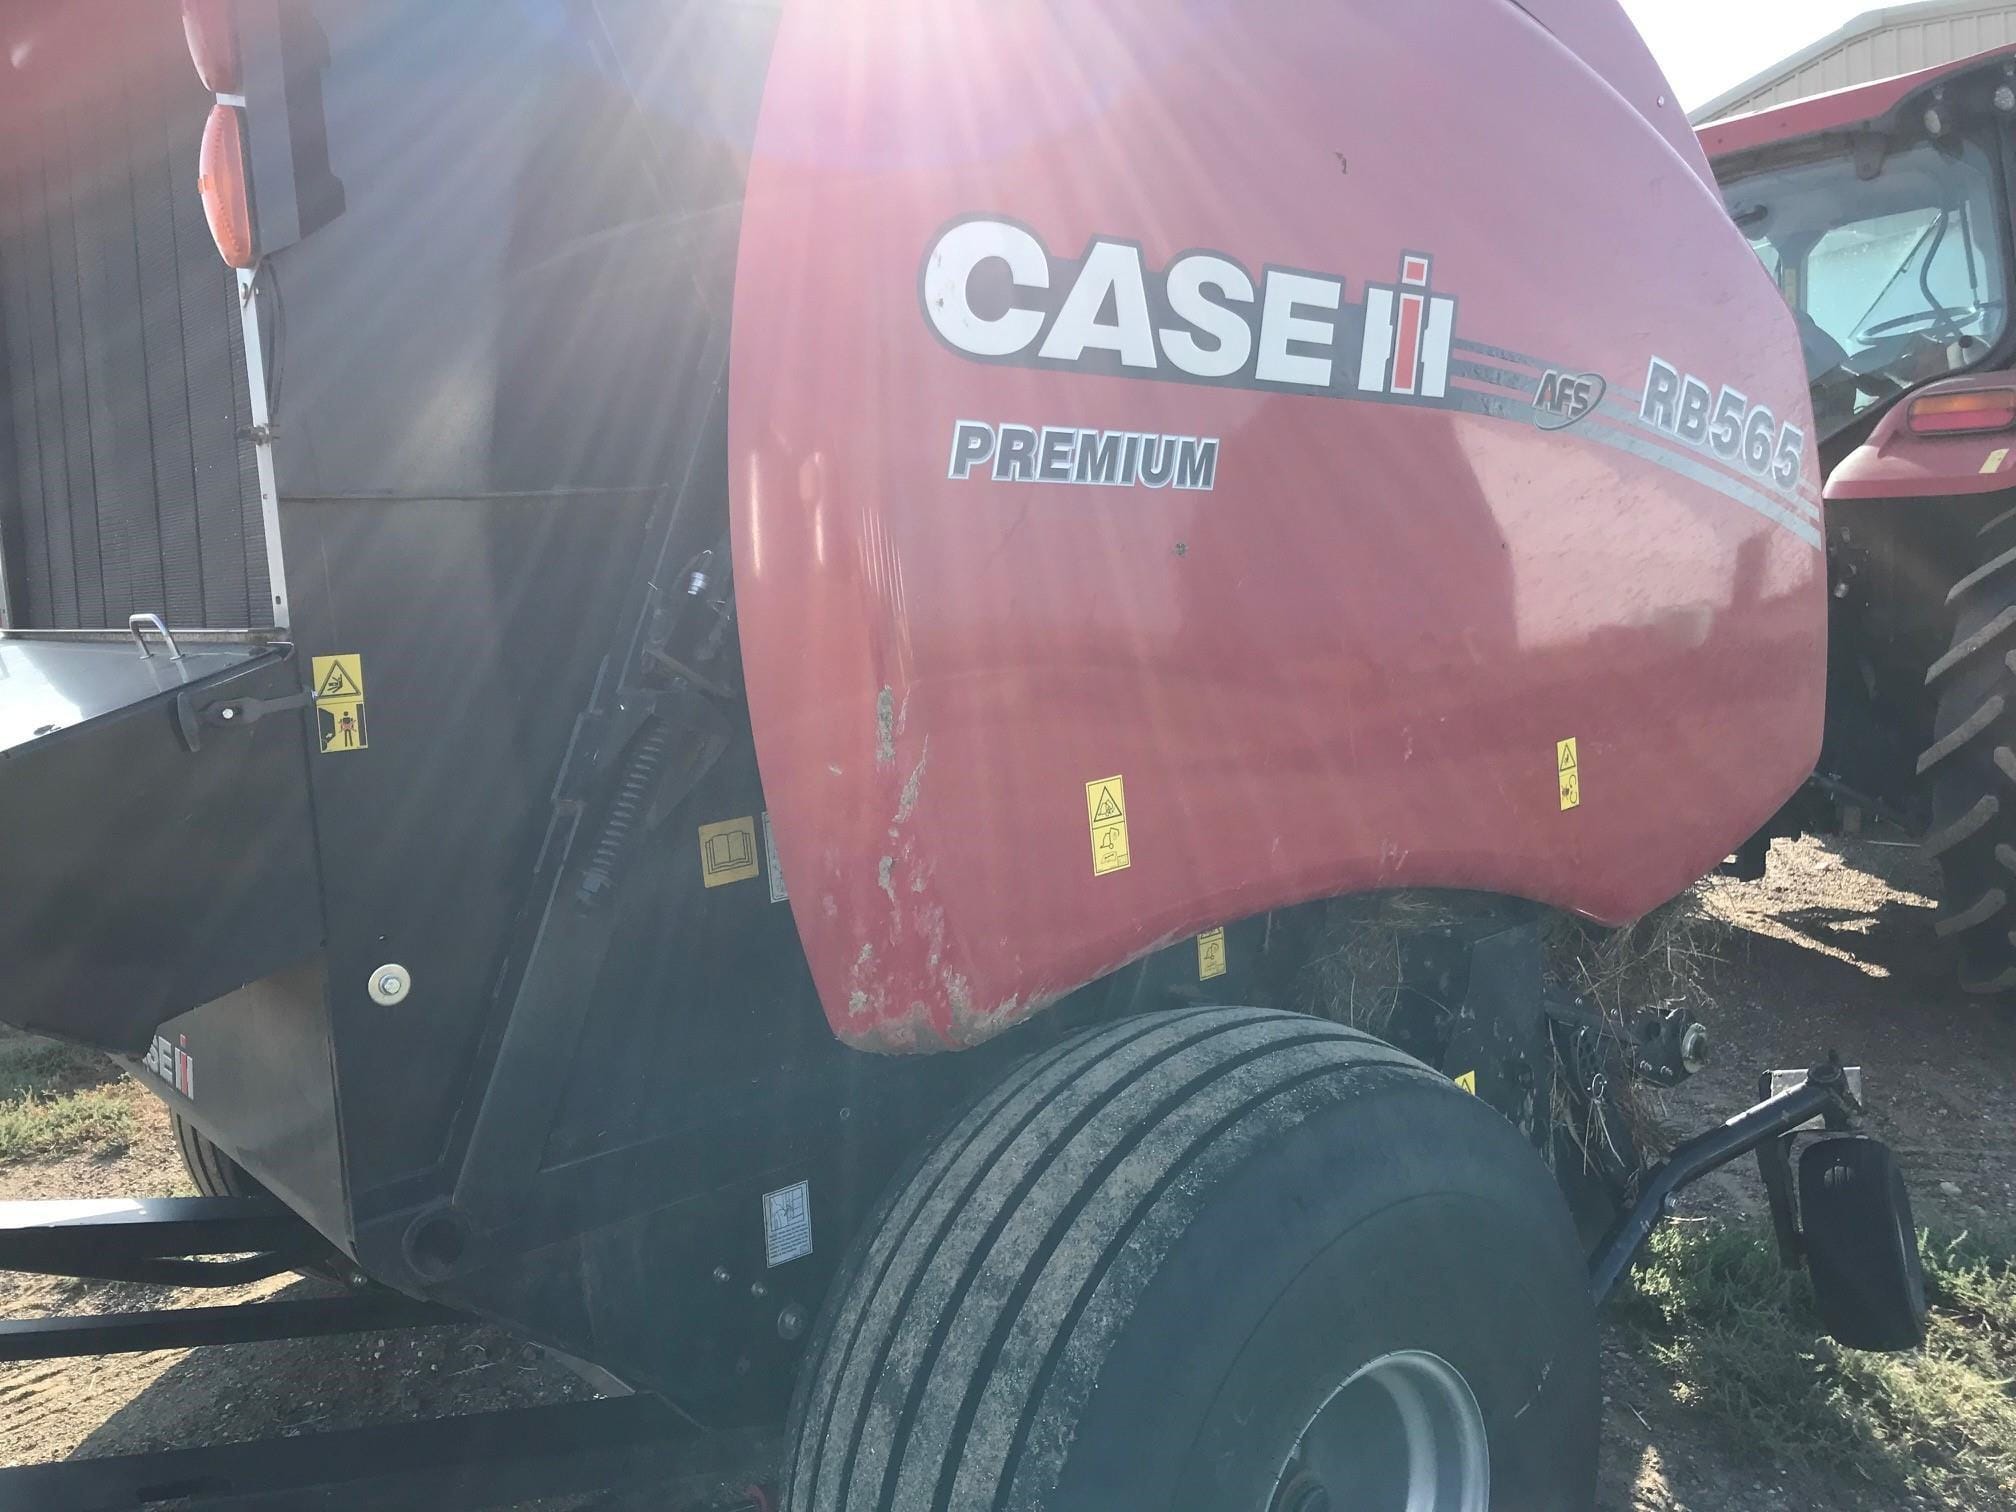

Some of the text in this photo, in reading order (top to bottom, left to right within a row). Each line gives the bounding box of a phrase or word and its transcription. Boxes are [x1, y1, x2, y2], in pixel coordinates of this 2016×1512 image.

[924, 220, 1342, 388] CASE
[1531, 368, 1594, 419] AFS
[1639, 354, 1804, 492] RB565
[947, 419, 1220, 491] PREMIUM
[142, 1034, 173, 1085] SE
